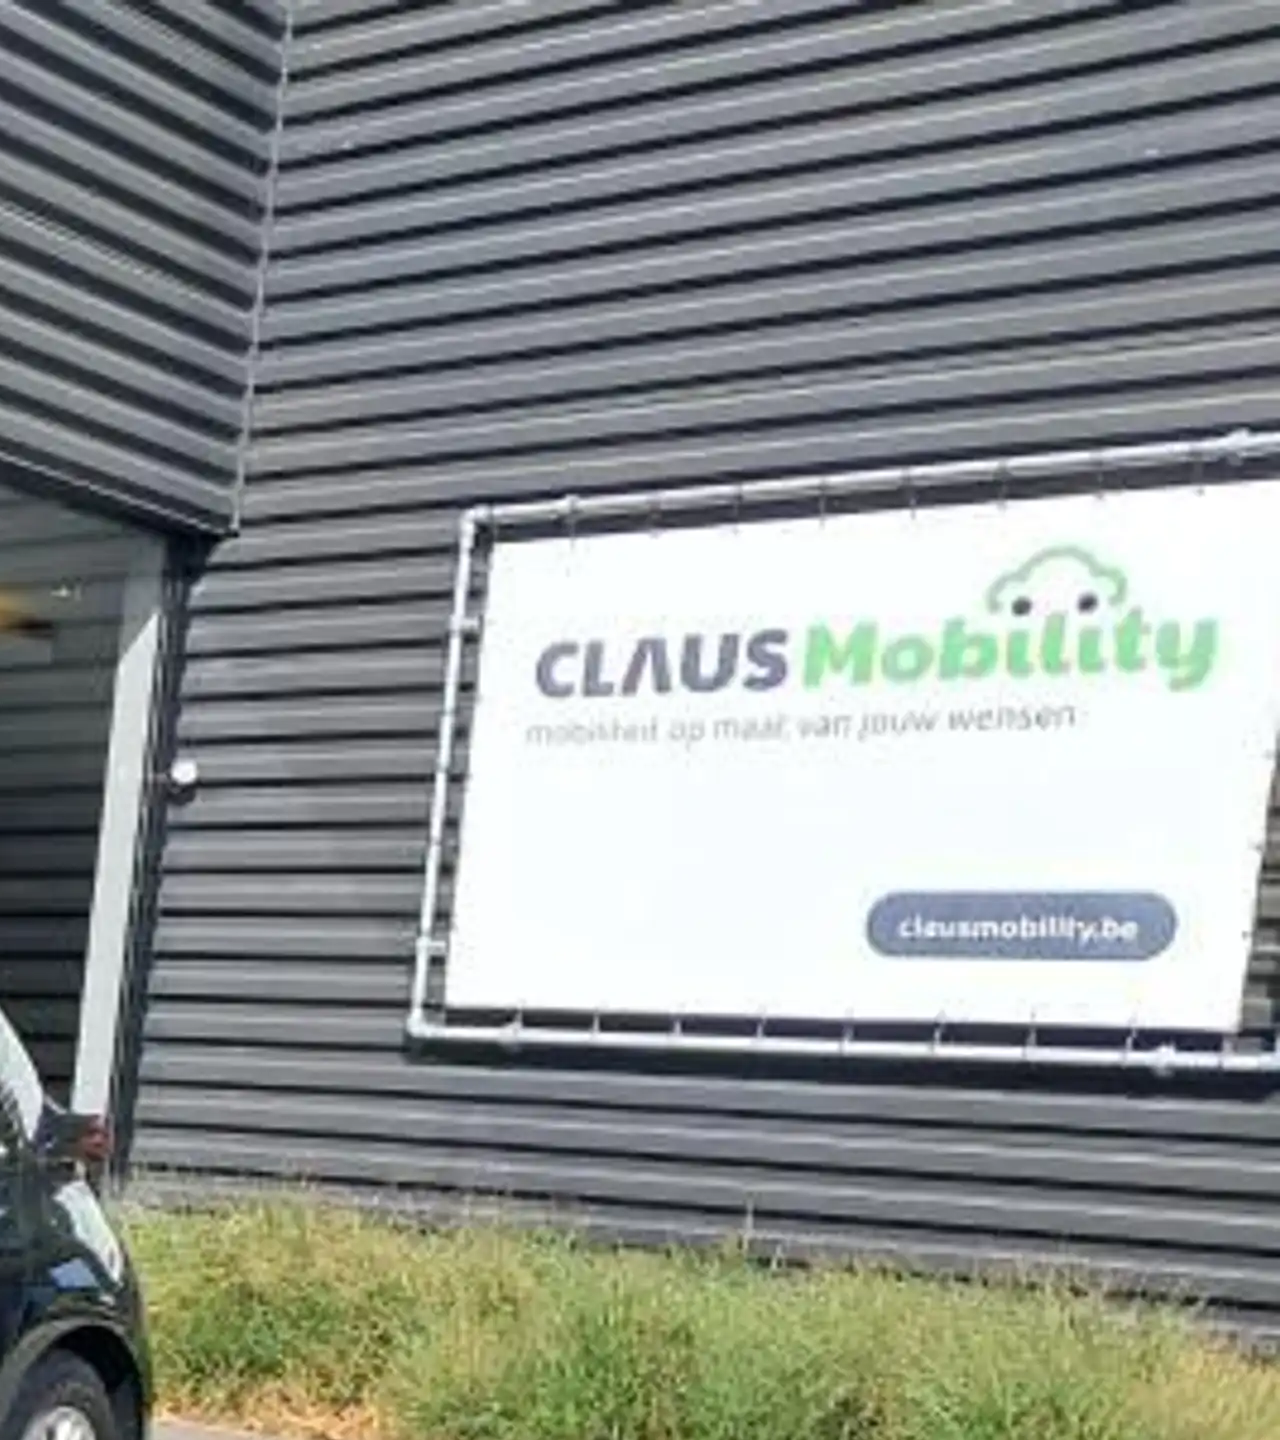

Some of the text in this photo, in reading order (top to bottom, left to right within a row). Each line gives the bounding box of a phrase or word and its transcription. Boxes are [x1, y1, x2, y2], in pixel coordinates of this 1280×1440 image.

[535, 606, 1219, 698] CLAUS Mobility
[948, 703, 1078, 732] wensen
[898, 913, 1140, 945] clausmobility.be
